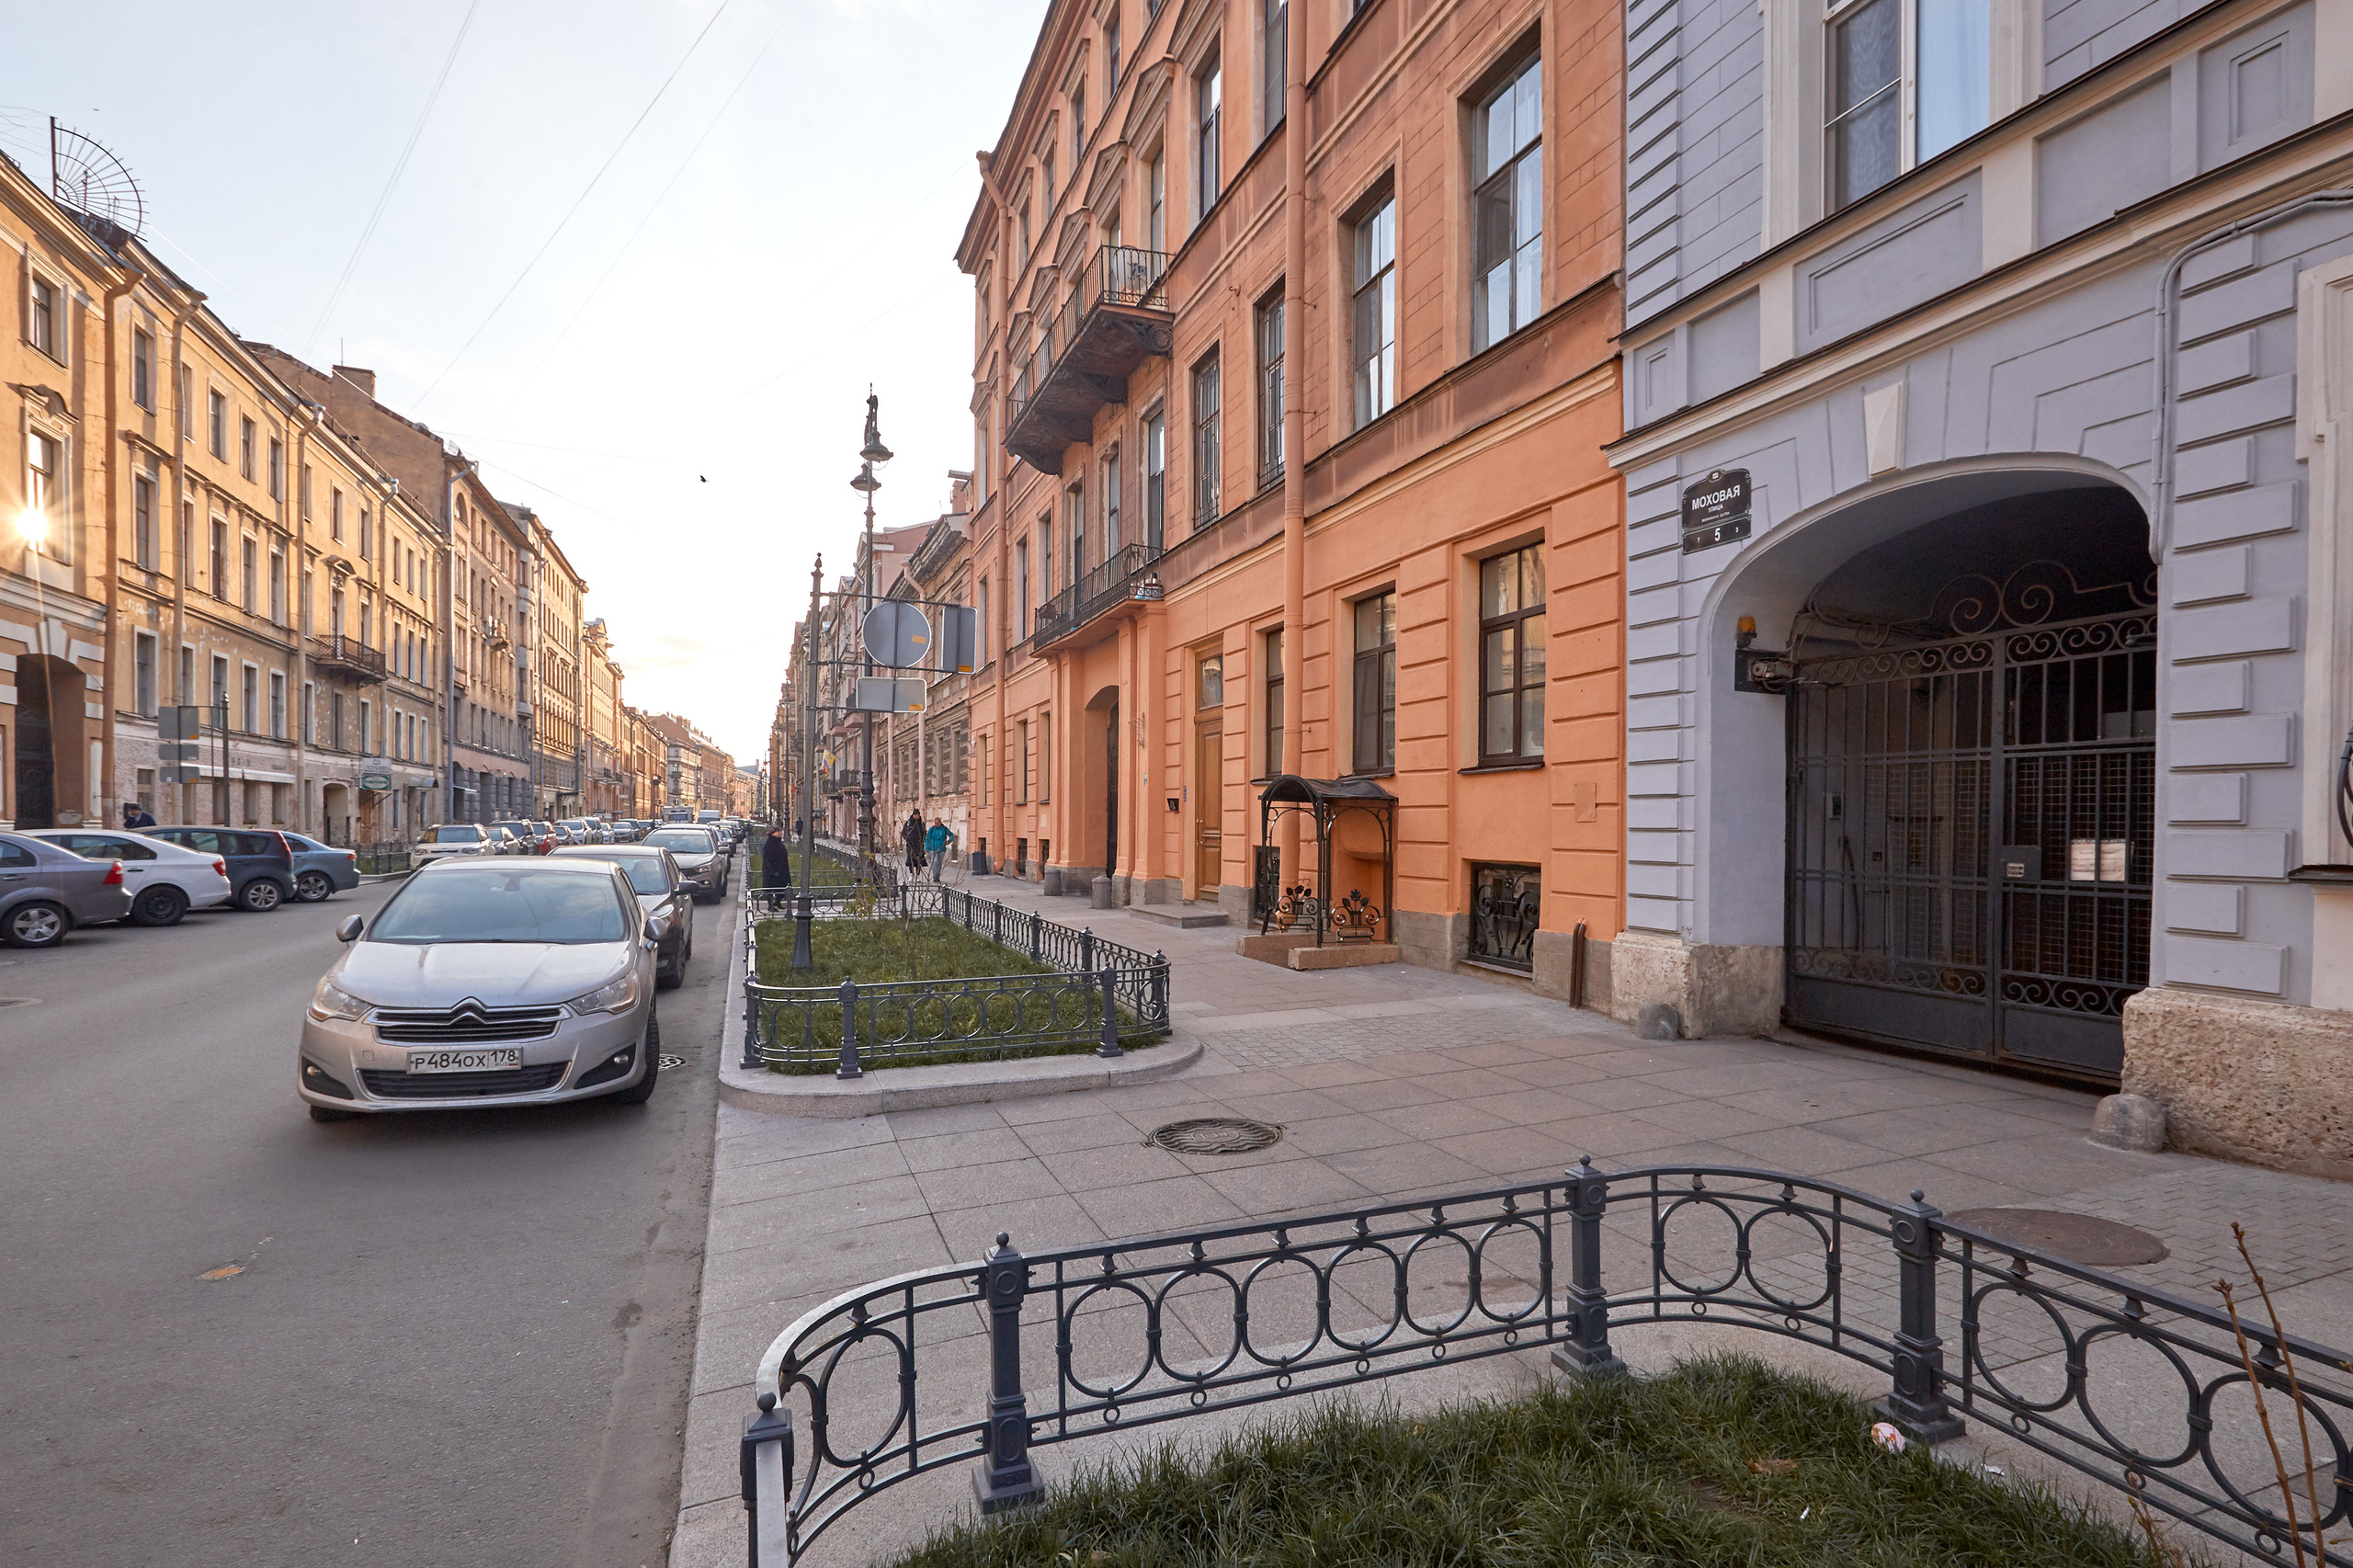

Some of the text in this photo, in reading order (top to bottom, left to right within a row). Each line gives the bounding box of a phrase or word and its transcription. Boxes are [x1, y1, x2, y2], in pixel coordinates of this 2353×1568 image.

[1692, 484, 1740, 510] МОХОВАЯ
[1714, 528, 1721, 541] 5
[490, 1051, 516, 1062] 178
